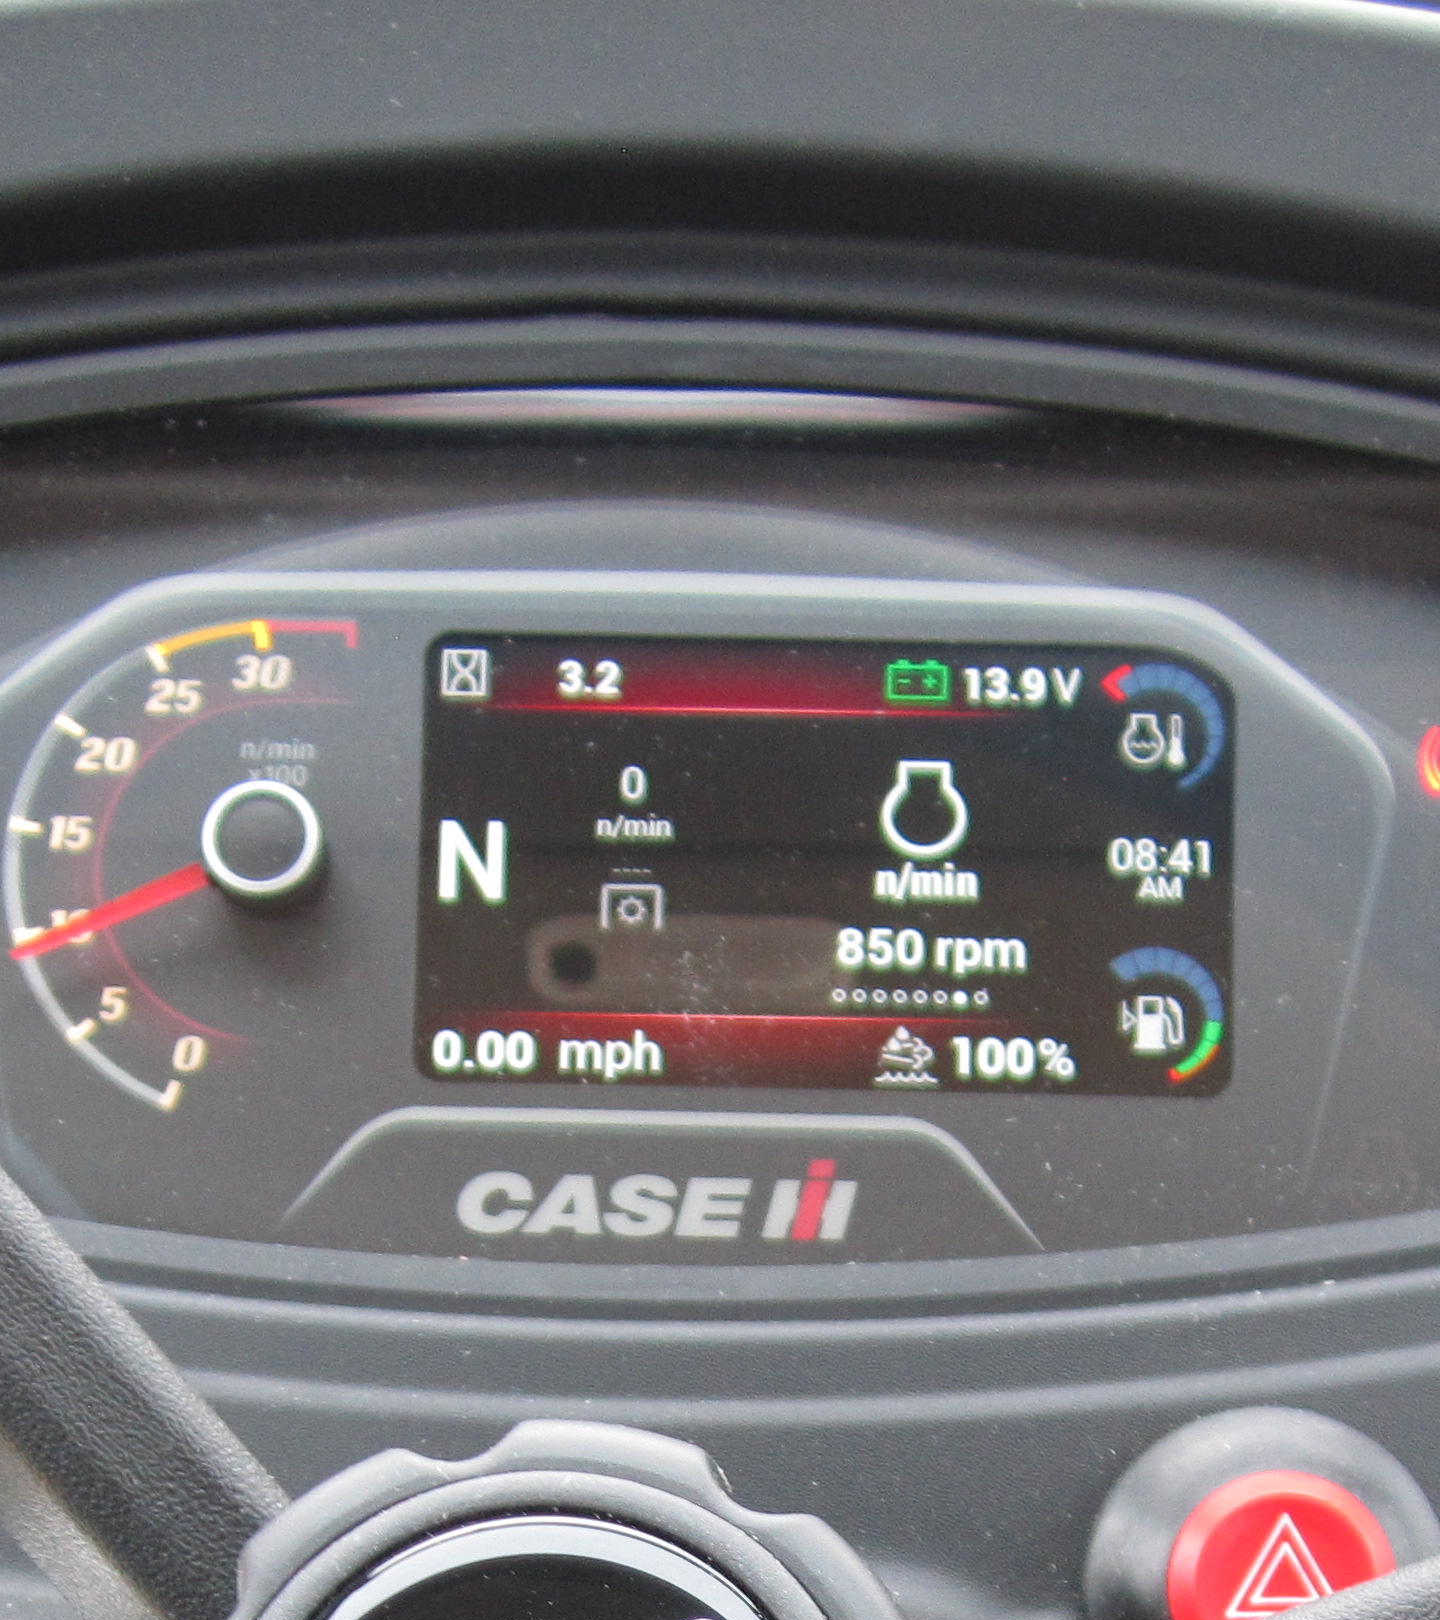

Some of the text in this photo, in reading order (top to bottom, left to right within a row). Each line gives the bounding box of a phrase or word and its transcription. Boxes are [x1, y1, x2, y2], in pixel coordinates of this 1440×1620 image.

[230, 654, 292, 690] 30
[557, 659, 623, 697] 3.2
[144, 677, 203, 714] 25
[72, 735, 137, 773] 20
[239, 739, 317, 761] n/min
[619, 765, 647, 802] 0
[48, 814, 93, 850] 15
[594, 812, 674, 840] n/min
[437, 819, 507, 903] N
[1107, 837, 1213, 876] 08:41
[873, 861, 979, 902] n/min
[1136, 877, 1185, 901] AM
[835, 926, 1028, 976] 850 rpm
[98, 986, 126, 1021] 5
[171, 1034, 205, 1071] 0
[431, 1028, 664, 1080] 0.00 mph
[951, 1035, 1076, 1079] 100%
[457, 1171, 752, 1237] CASE
